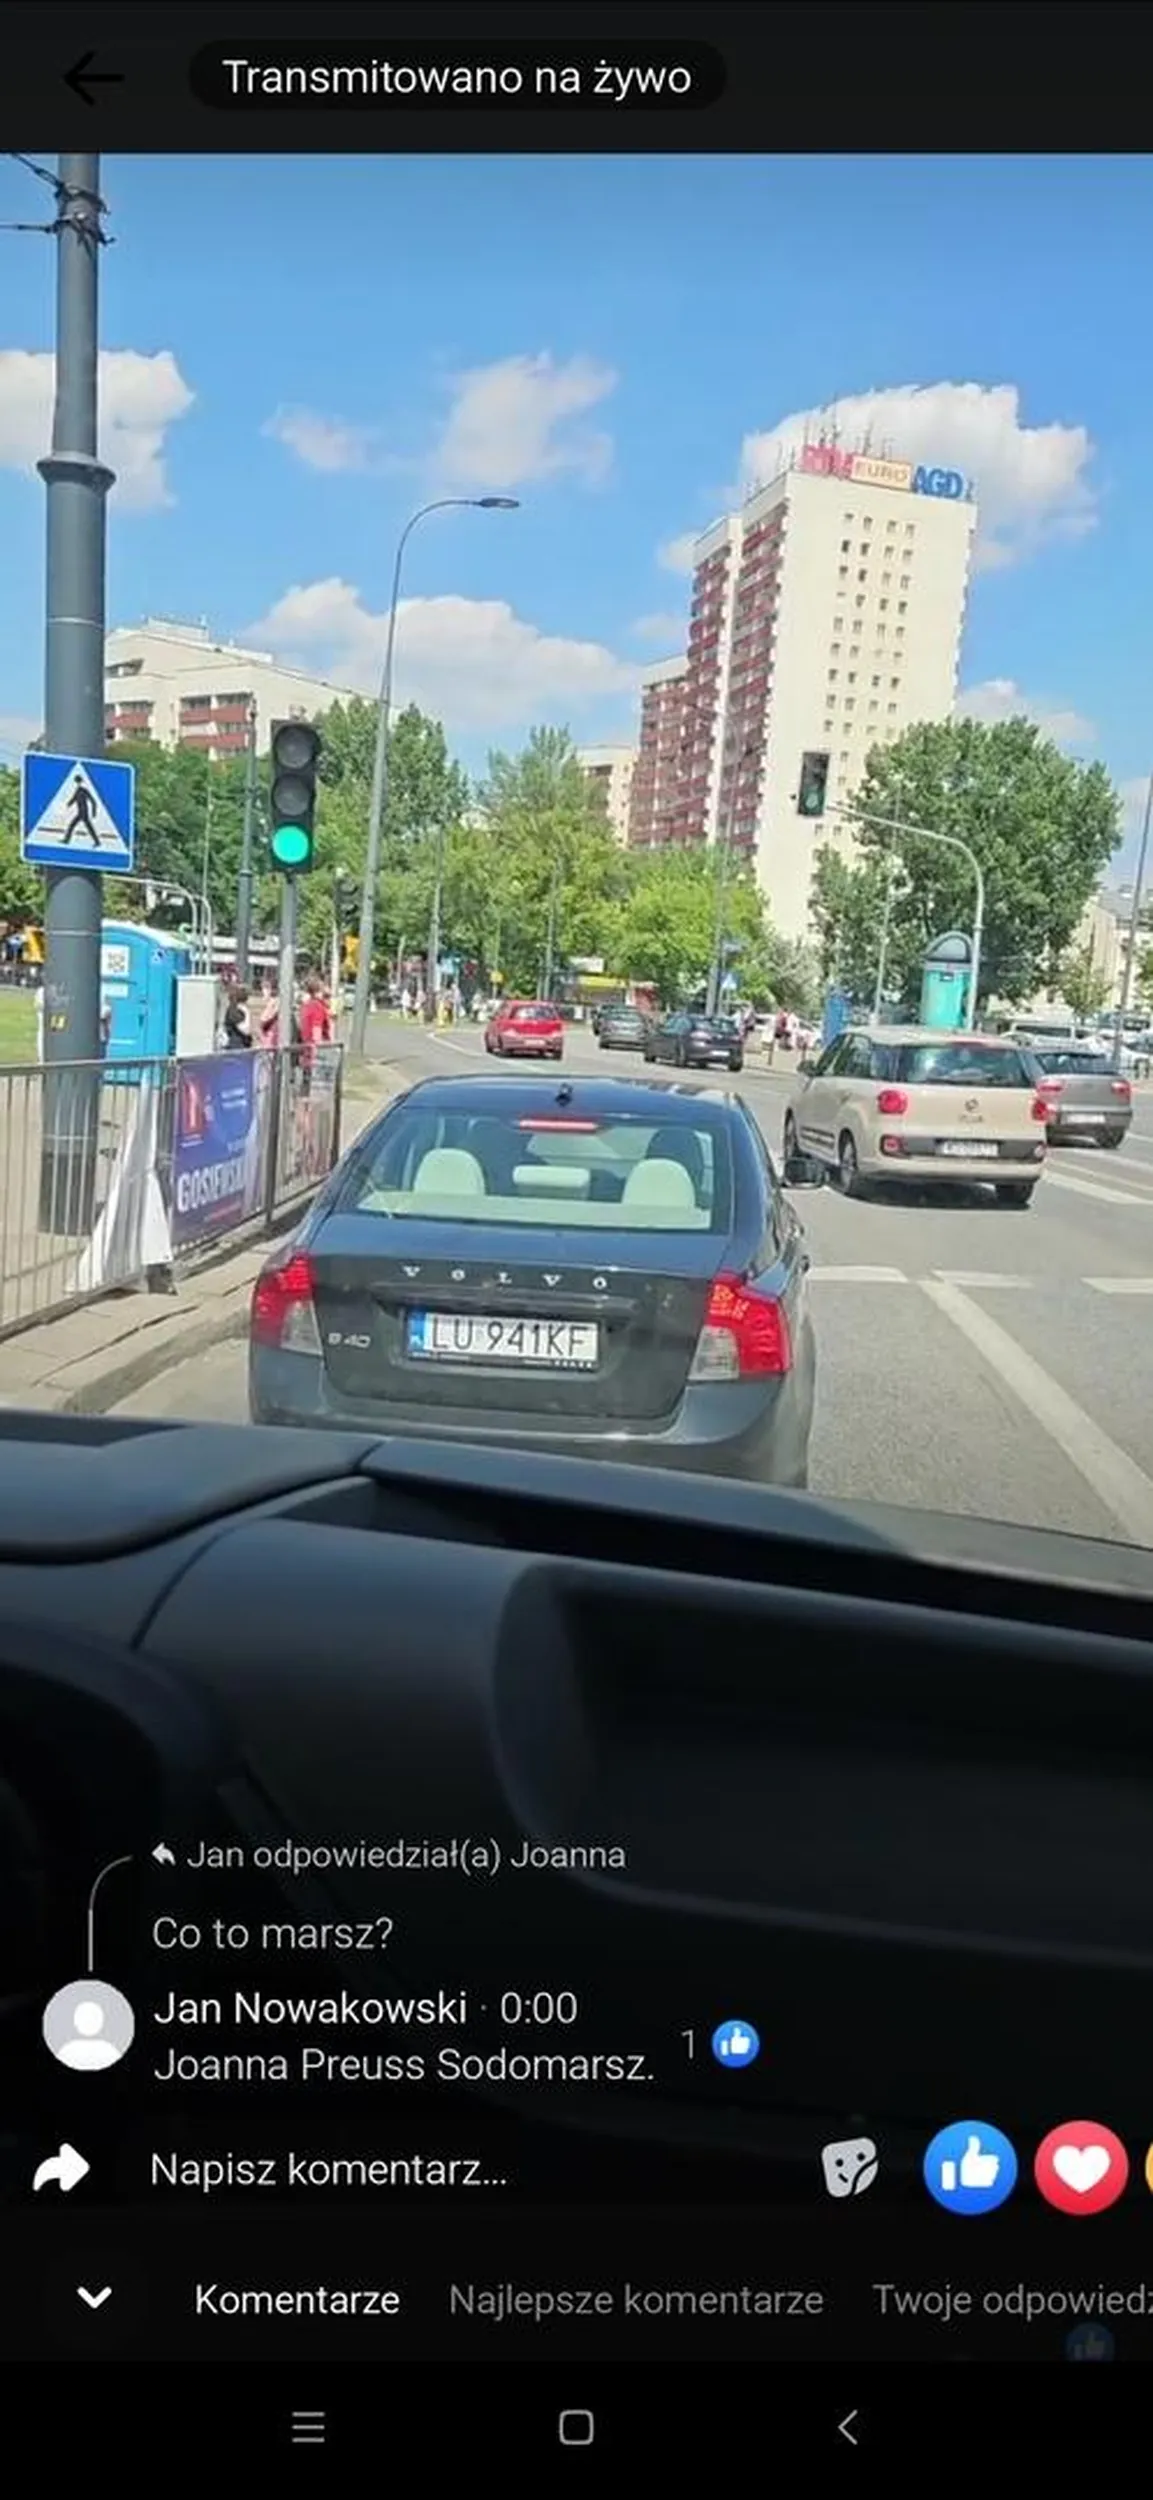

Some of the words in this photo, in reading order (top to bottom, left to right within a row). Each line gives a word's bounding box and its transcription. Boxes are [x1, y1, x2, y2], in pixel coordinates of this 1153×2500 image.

[911, 464, 965, 499] AGD
[403, 1265, 608, 1290] VOLVO
[431, 1316, 474, 1351] LU
[486, 1320, 590, 1357] 941KF
